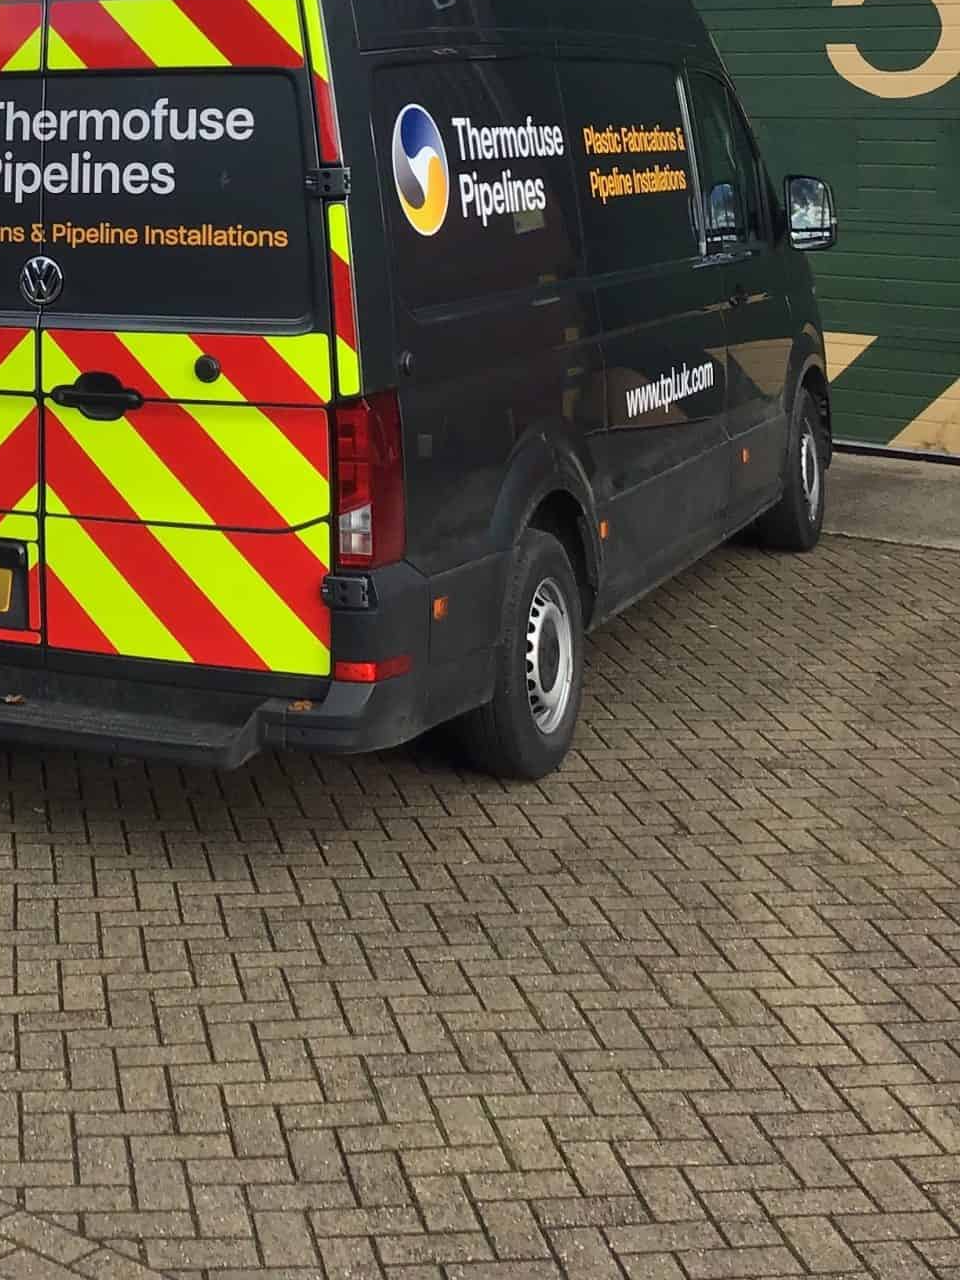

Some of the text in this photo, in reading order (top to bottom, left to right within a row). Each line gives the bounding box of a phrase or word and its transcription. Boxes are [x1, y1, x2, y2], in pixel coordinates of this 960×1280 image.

[451, 116, 564, 161] Thermofuse
[583, 124, 621, 155] Plastic
[620, 124, 677, 153] Fabrications
[458, 169, 546, 227] Pipelines
[589, 163, 687, 204] Pipeline Installations
[30, 223, 46, 243] &
[52, 223, 138, 249] Pipeline
[145, 224, 289, 248] Installations
[626, 361, 714, 418] www.tpl.uk.com
